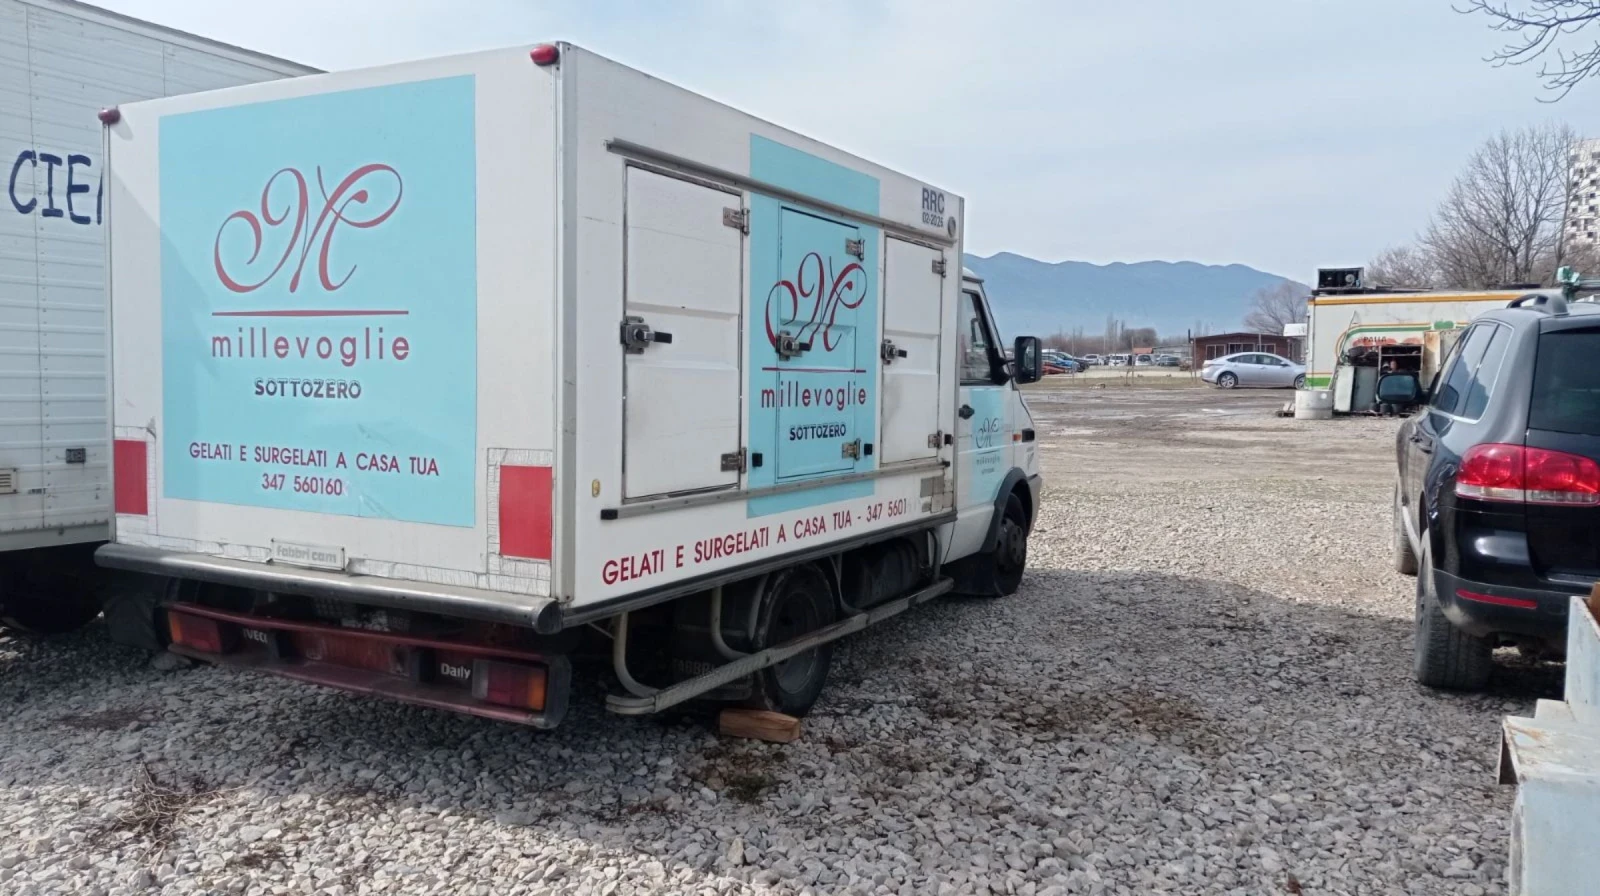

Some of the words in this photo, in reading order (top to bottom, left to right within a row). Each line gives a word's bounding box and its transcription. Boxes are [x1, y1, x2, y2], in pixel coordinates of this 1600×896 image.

[922, 187, 945, 214] RRC
[211, 327, 410, 367] millevoglie
[254, 377, 362, 399] SOTTOZERO
[761, 381, 867, 411] millevoglie
[789, 423, 847, 441] SOTTOZERO
[189, 442, 232, 460] GELATI
[240, 445, 247, 461] E
[254, 446, 327, 467] SURGELATI
[336, 452, 347, 468] A
[356, 453, 400, 473] CASA
[409, 456, 439, 476] TUA
[261, 473, 285, 490] 347
[293, 476, 343, 496] 560160
[602, 549, 665, 585] GELATI
[676, 545, 684, 568] E
[694, 526, 770, 563] SURGELATI
[777, 523, 787, 543] A
[794, 518, 827, 540] CASA
[833, 509, 852, 531] TUA
[866, 502, 883, 523] 347
[440, 662, 471, 680] Daily
